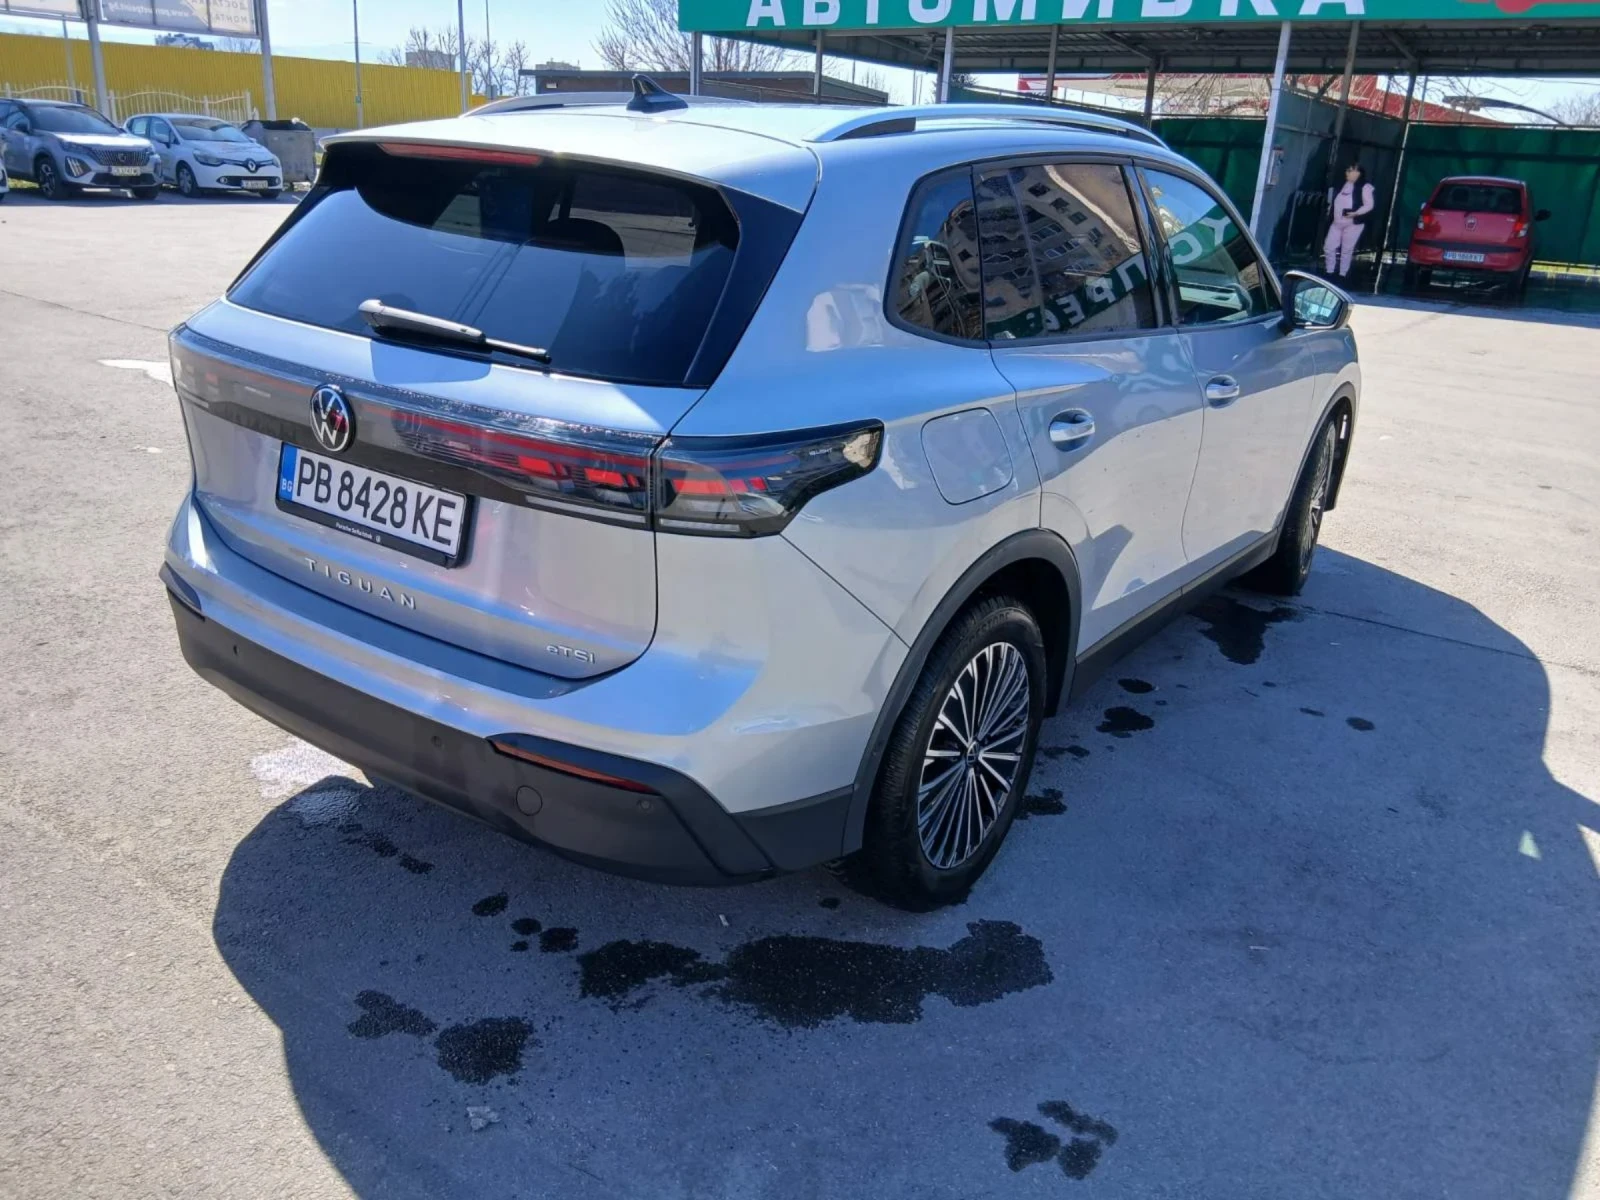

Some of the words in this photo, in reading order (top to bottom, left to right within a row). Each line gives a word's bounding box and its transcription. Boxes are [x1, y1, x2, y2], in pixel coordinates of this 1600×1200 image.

[281, 478, 293, 493] BG
[297, 456, 332, 504] PB
[337, 470, 408, 529] 8428
[412, 491, 456, 546] KE
[305, 557, 417, 610] TIGUAN
[546, 644, 596, 664] eTSI
